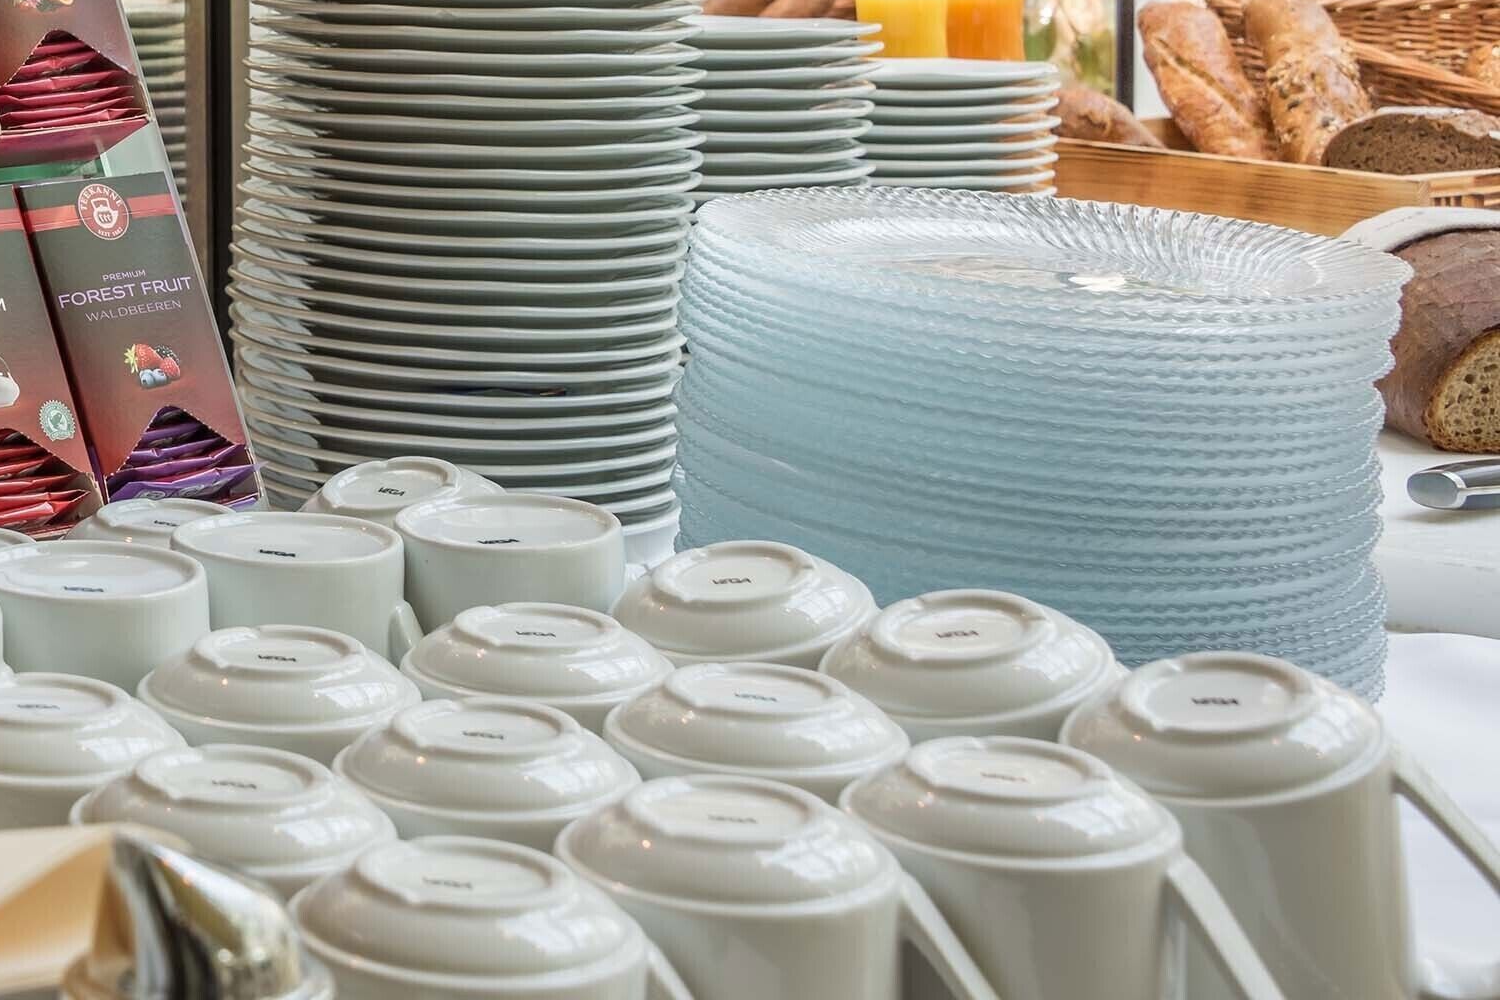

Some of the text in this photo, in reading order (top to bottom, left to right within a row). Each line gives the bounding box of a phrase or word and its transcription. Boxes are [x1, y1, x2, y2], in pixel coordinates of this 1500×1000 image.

[81, 185, 123, 211] TEEKANNE
[102, 269, 146, 282] PREMIUM
[58, 276, 192, 309] FOREST FRUIT
[85, 299, 182, 322] WALDBEEREN
[378, 487, 405, 497] VEGA
